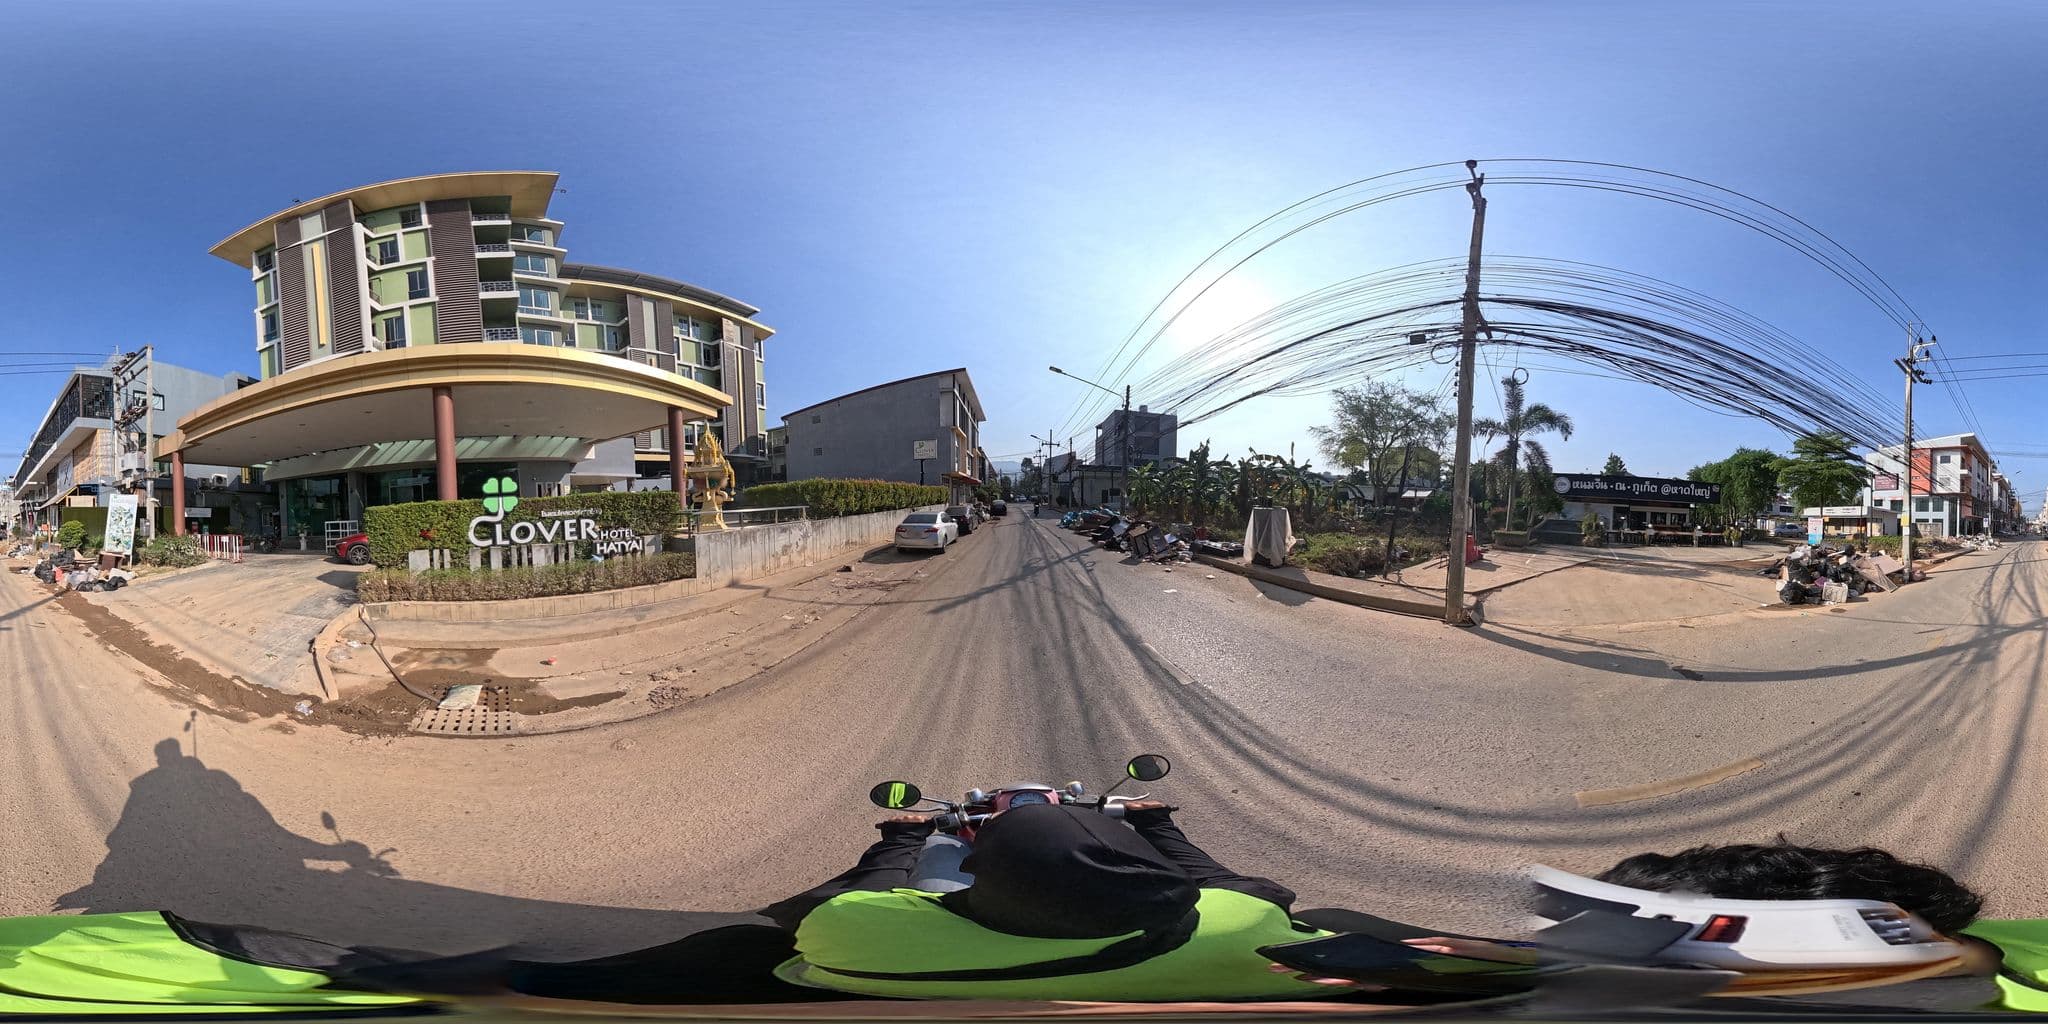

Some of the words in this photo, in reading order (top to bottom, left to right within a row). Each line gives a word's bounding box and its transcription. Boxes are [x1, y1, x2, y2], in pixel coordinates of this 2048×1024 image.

[468, 513, 599, 547] CLOVER
[600, 528, 635, 541] HOTEL
[596, 539, 643, 555] HATYAI
